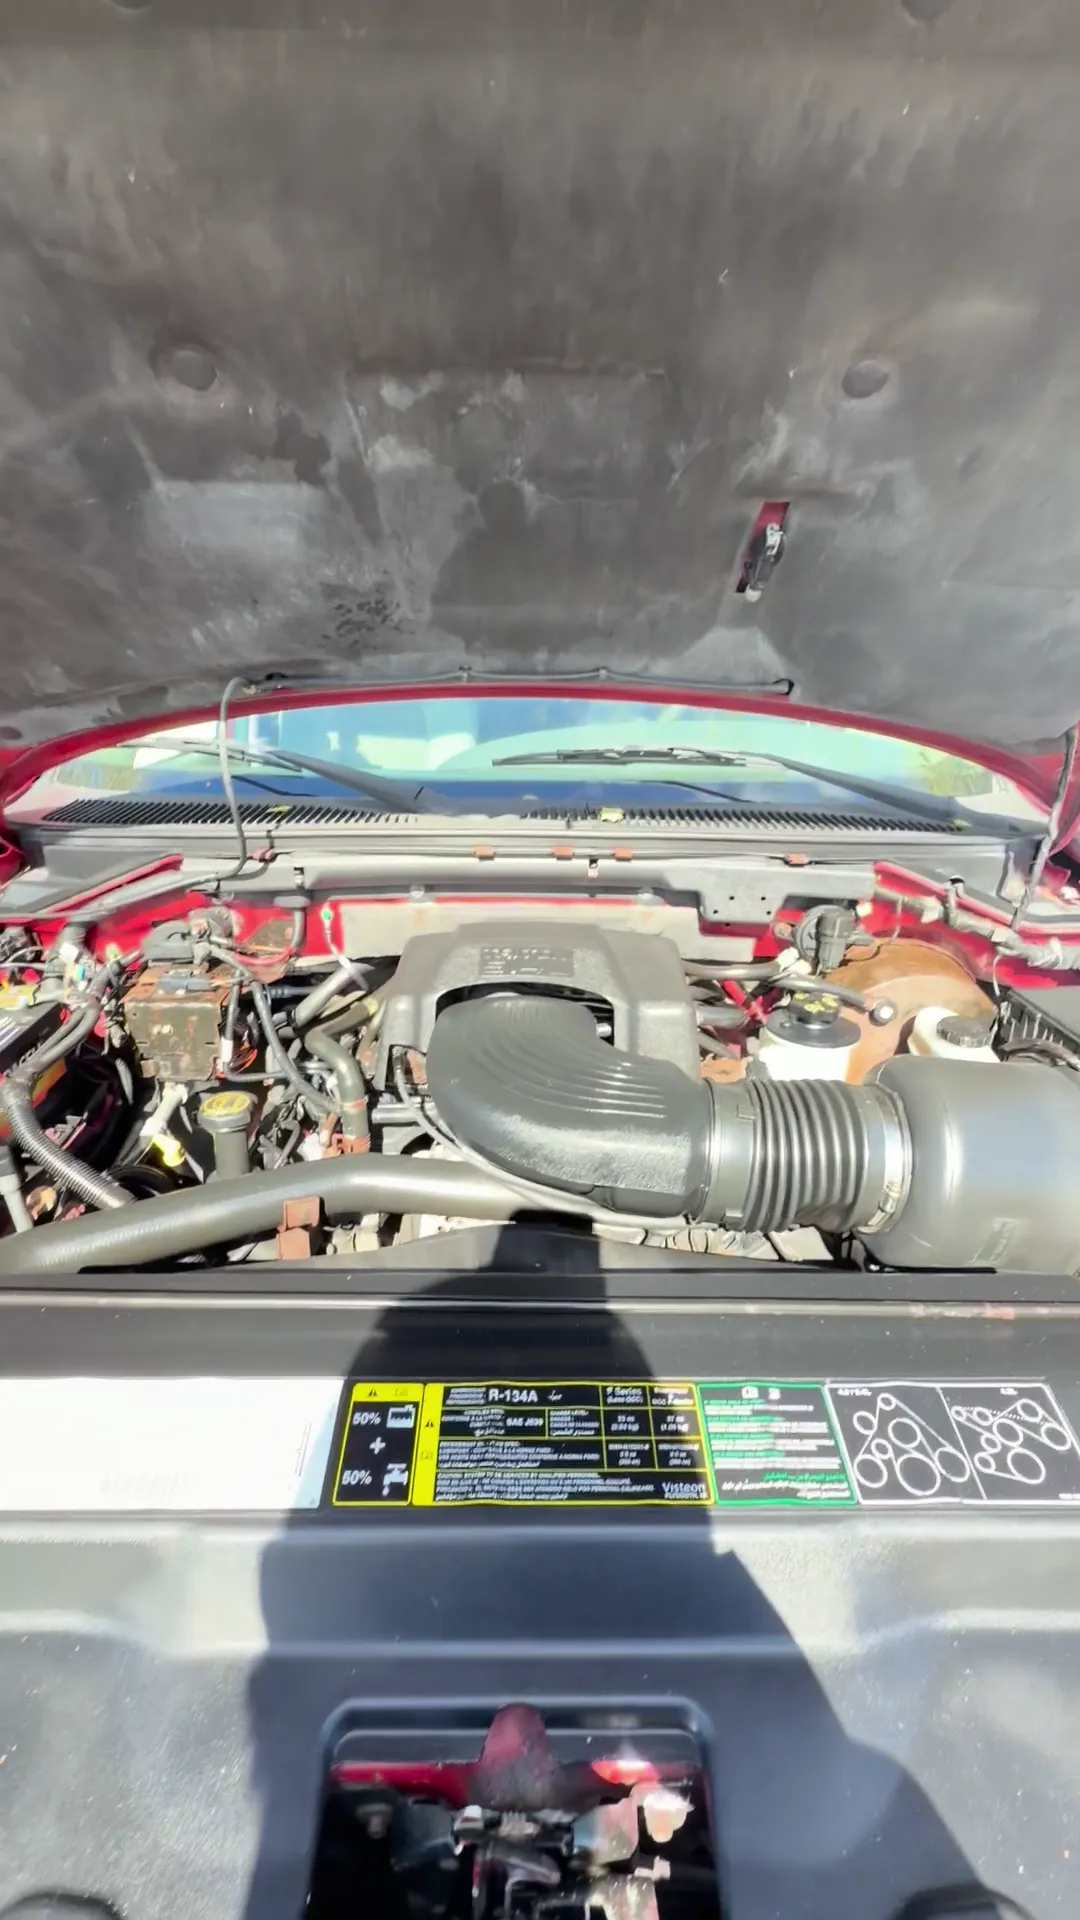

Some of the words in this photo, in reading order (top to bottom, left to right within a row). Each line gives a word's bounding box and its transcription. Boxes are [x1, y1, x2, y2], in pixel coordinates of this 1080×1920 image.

[488, 1388, 539, 1403] R-134A
[351, 1412, 382, 1426] 50%
[341, 1470, 373, 1486] 50%
[661, 1481, 707, 1493] Visteon
